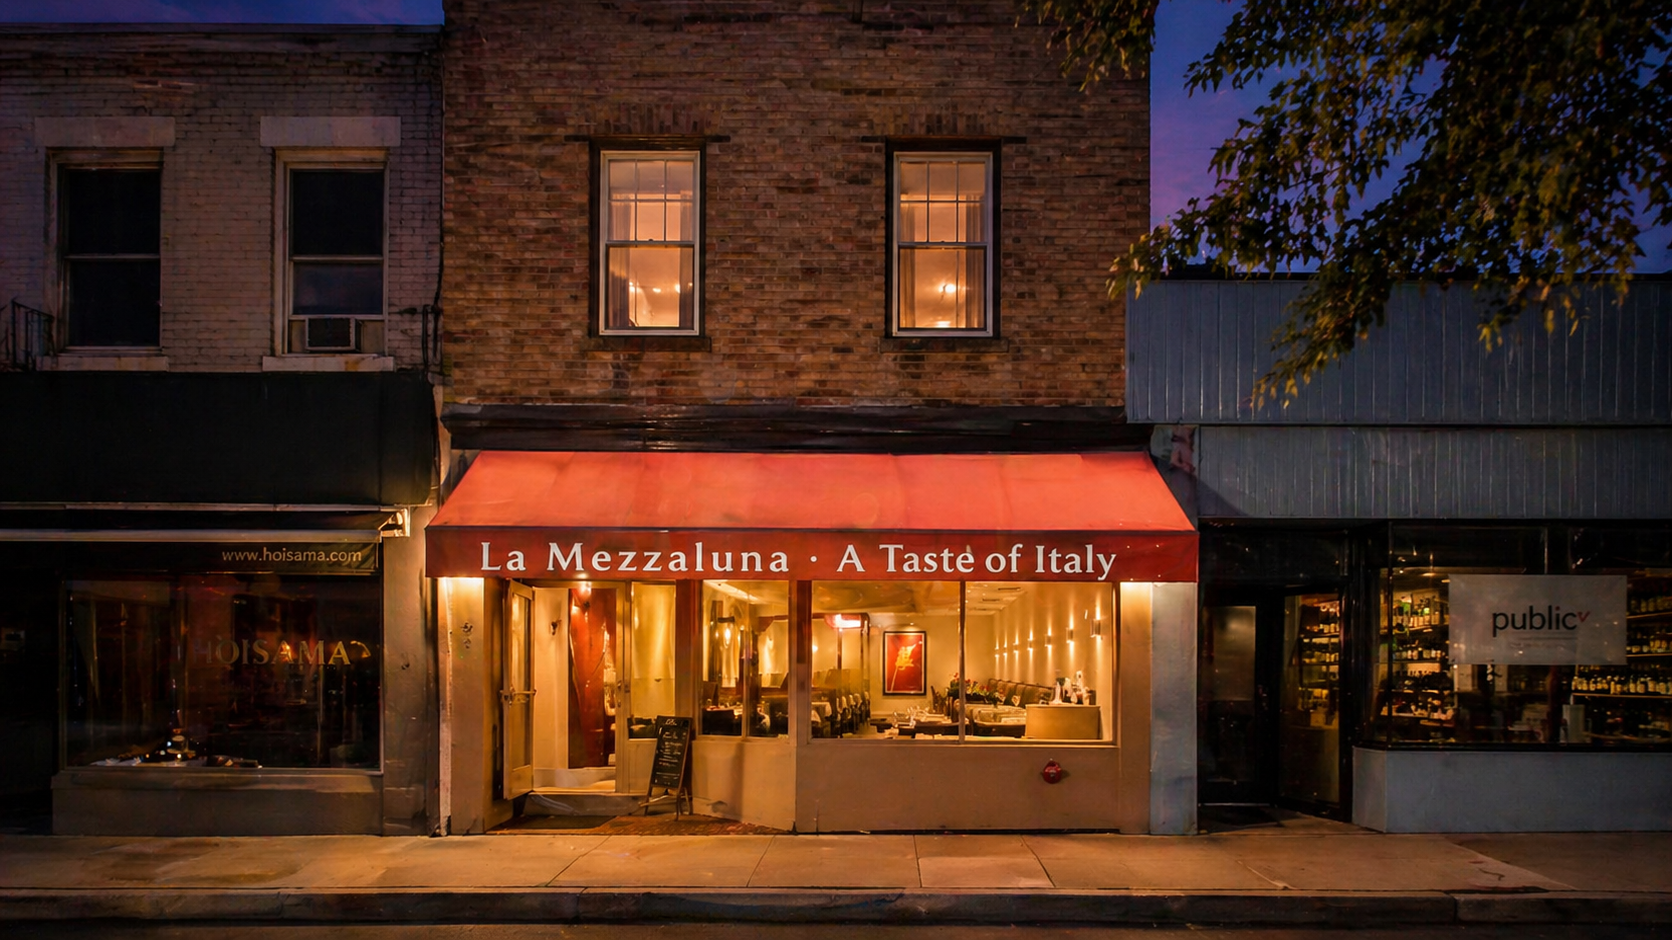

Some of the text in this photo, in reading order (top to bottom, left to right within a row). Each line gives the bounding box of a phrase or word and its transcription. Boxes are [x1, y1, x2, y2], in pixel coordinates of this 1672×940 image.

[222, 547, 362, 562] www.hoisama.com
[481, 541, 526, 571] La
[547, 542, 789, 572] Mezzaluna
[836, 544, 865, 572] A
[879, 544, 974, 573] Taste
[985, 543, 1023, 573] of
[1035, 544, 1116, 580] Italy
